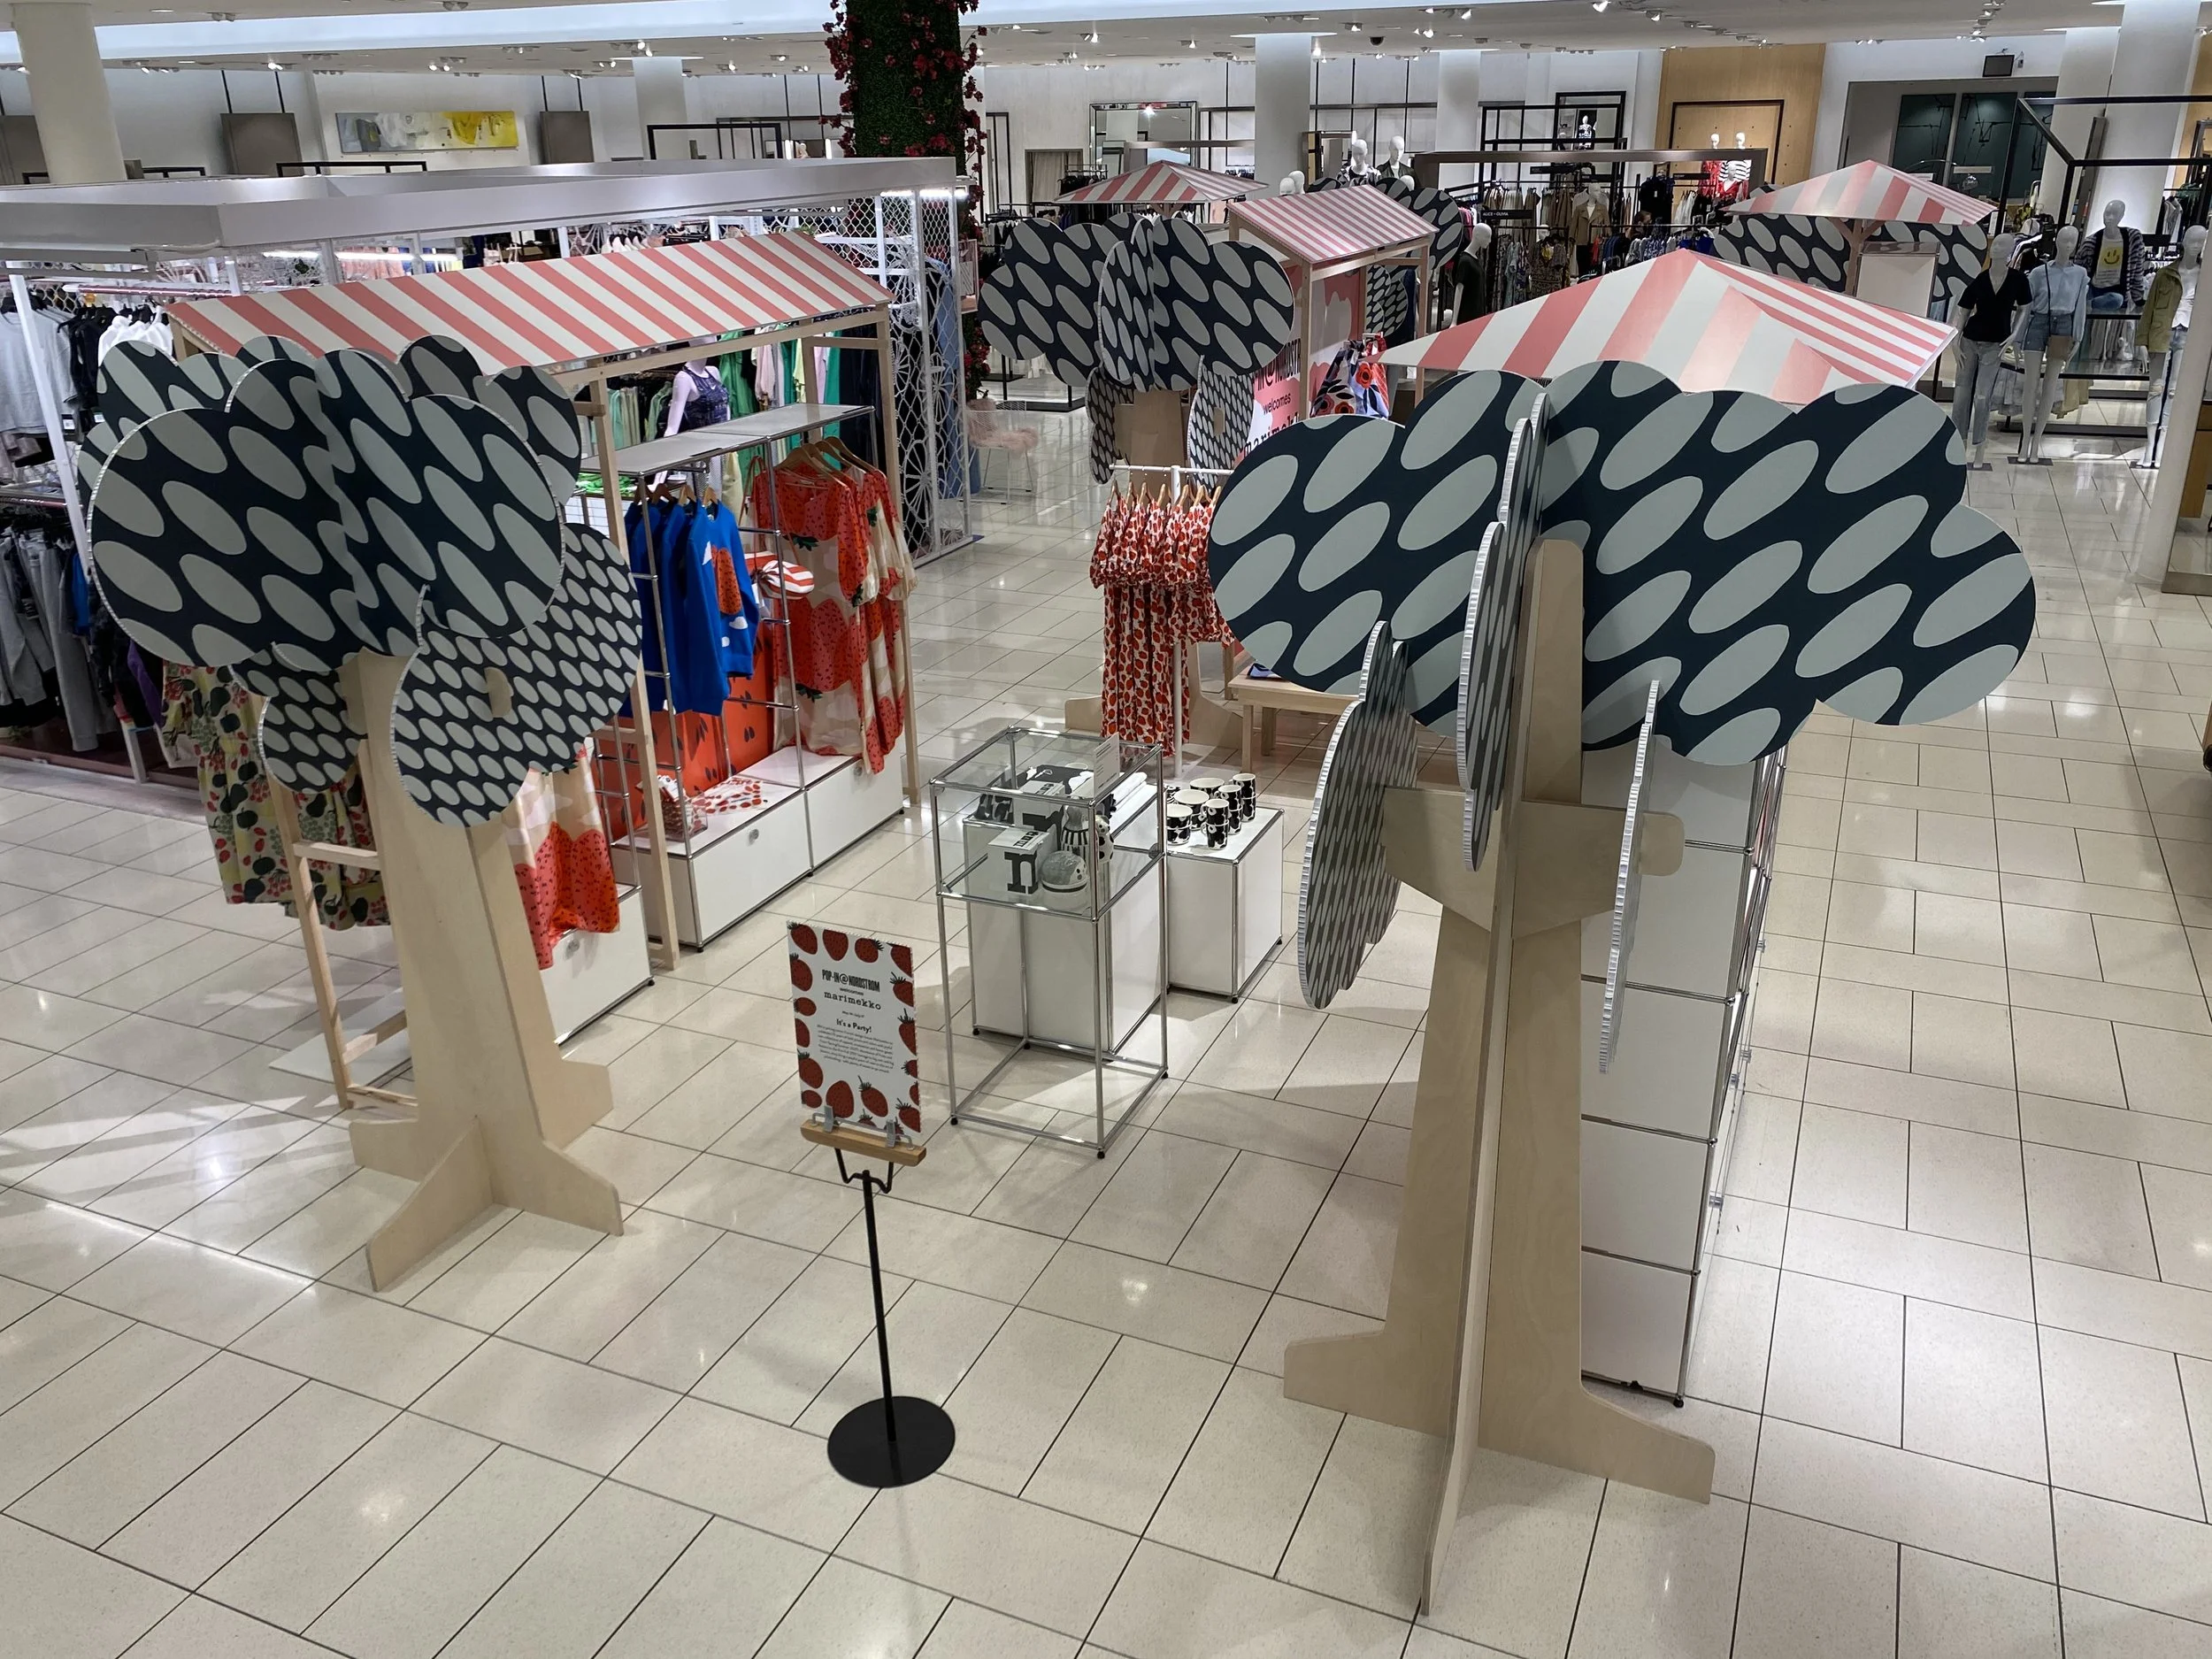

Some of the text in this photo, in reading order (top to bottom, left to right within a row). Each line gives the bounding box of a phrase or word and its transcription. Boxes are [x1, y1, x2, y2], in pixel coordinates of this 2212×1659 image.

[1263, 393, 1291, 415] welcomes
[822, 969, 880, 992] POP-IN@NORDSTROM
[824, 992, 881, 1010] marimekko
[836, 1018, 846, 1027] It's
[852, 1023, 872, 1033] Party!
